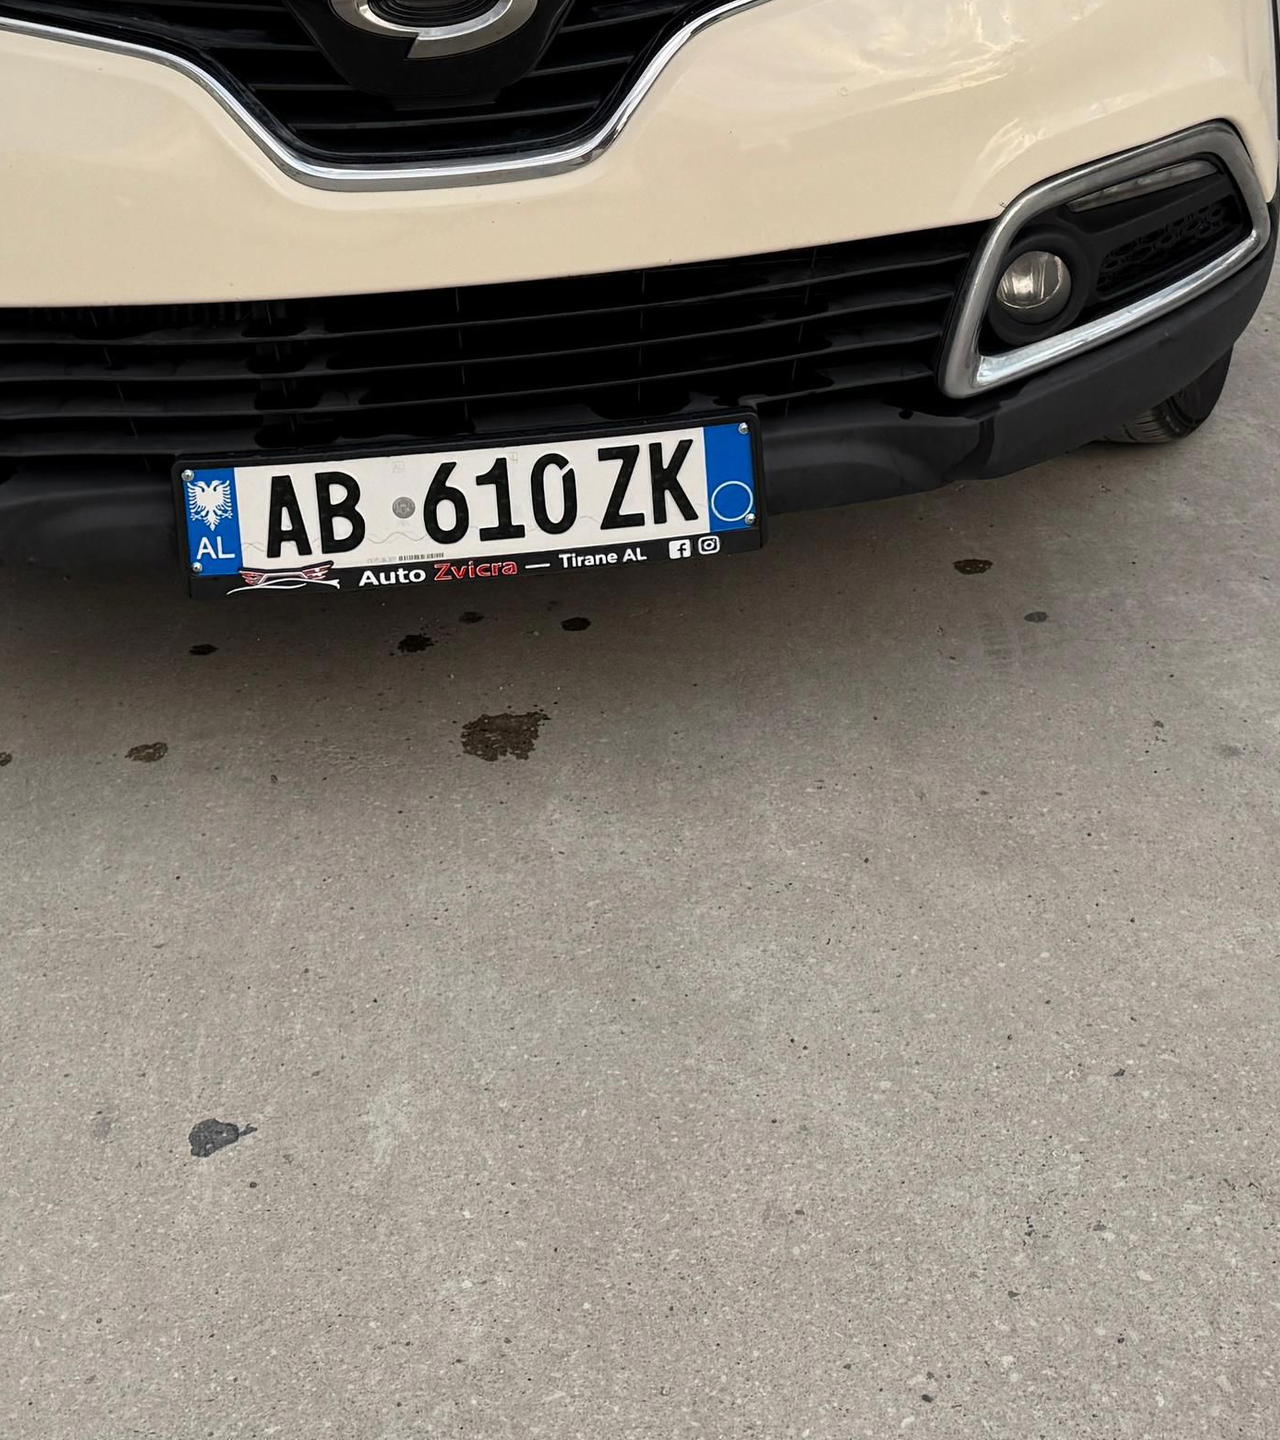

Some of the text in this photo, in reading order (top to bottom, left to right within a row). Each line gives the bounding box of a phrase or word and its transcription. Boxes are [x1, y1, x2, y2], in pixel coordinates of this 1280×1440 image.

[267, 439, 699, 558] AB 610 ZK
[196, 536, 235, 560] AL
[358, 568, 427, 587] Auto
[433, 560, 519, 582] Zvicra
[558, 551, 619, 569] Tirane
[622, 547, 648, 563] AL
